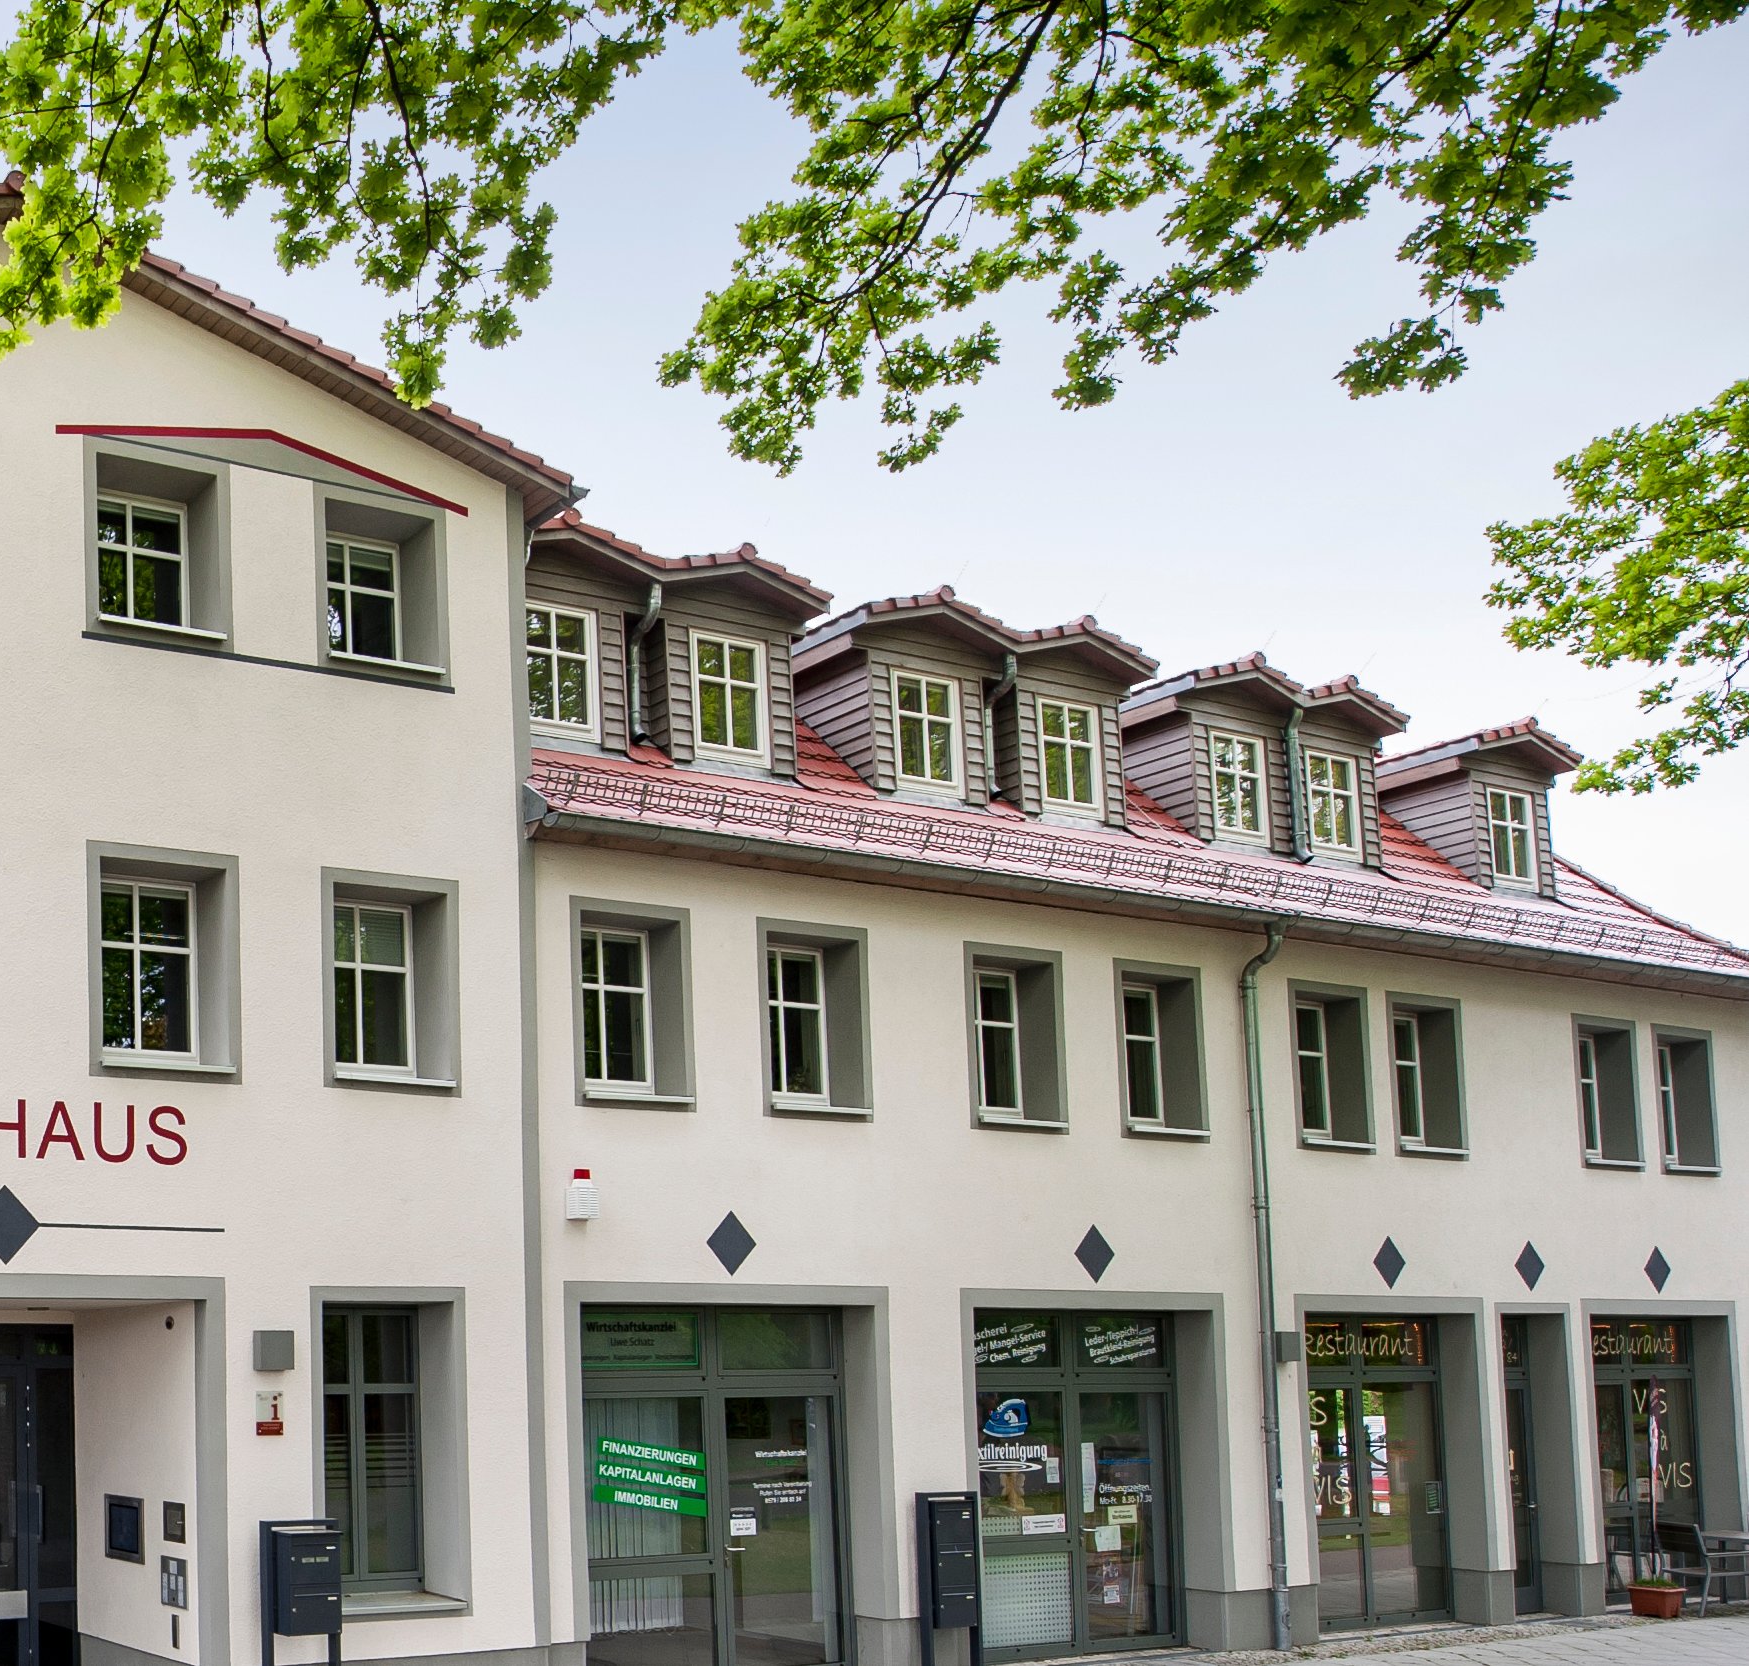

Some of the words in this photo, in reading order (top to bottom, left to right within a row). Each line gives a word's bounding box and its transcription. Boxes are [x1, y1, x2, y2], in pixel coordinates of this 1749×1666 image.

[586, 1321, 677, 1333] Wirtschaftskanzlei
[1633, 1388, 1668, 1414] VS
[602, 1440, 697, 1466] FINANZIERUNGEN
[599, 1464, 697, 1489] KAPITALANLAGEN
[1658, 1462, 1692, 1488] VIS
[614, 1490, 678, 1510] IMMOBILIEN
[1313, 1475, 1352, 1505] VIS
